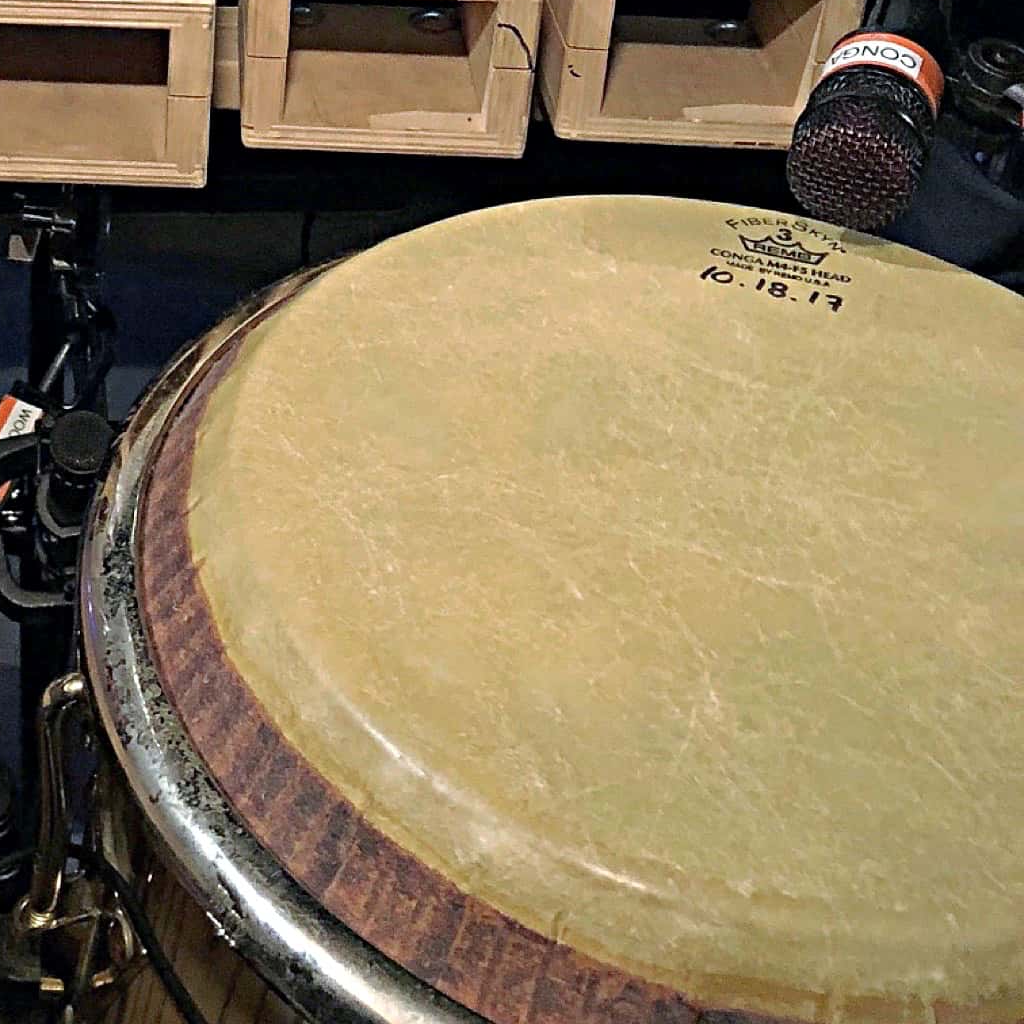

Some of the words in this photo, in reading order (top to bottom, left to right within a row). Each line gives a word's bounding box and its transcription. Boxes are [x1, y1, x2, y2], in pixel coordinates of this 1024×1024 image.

[831, 44, 917, 70] CONGA
[776, 228, 792, 241] 3
[753, 242, 812, 261] REMO
[710, 247, 764, 266] CONGA
[811, 269, 852, 283] HEAD
